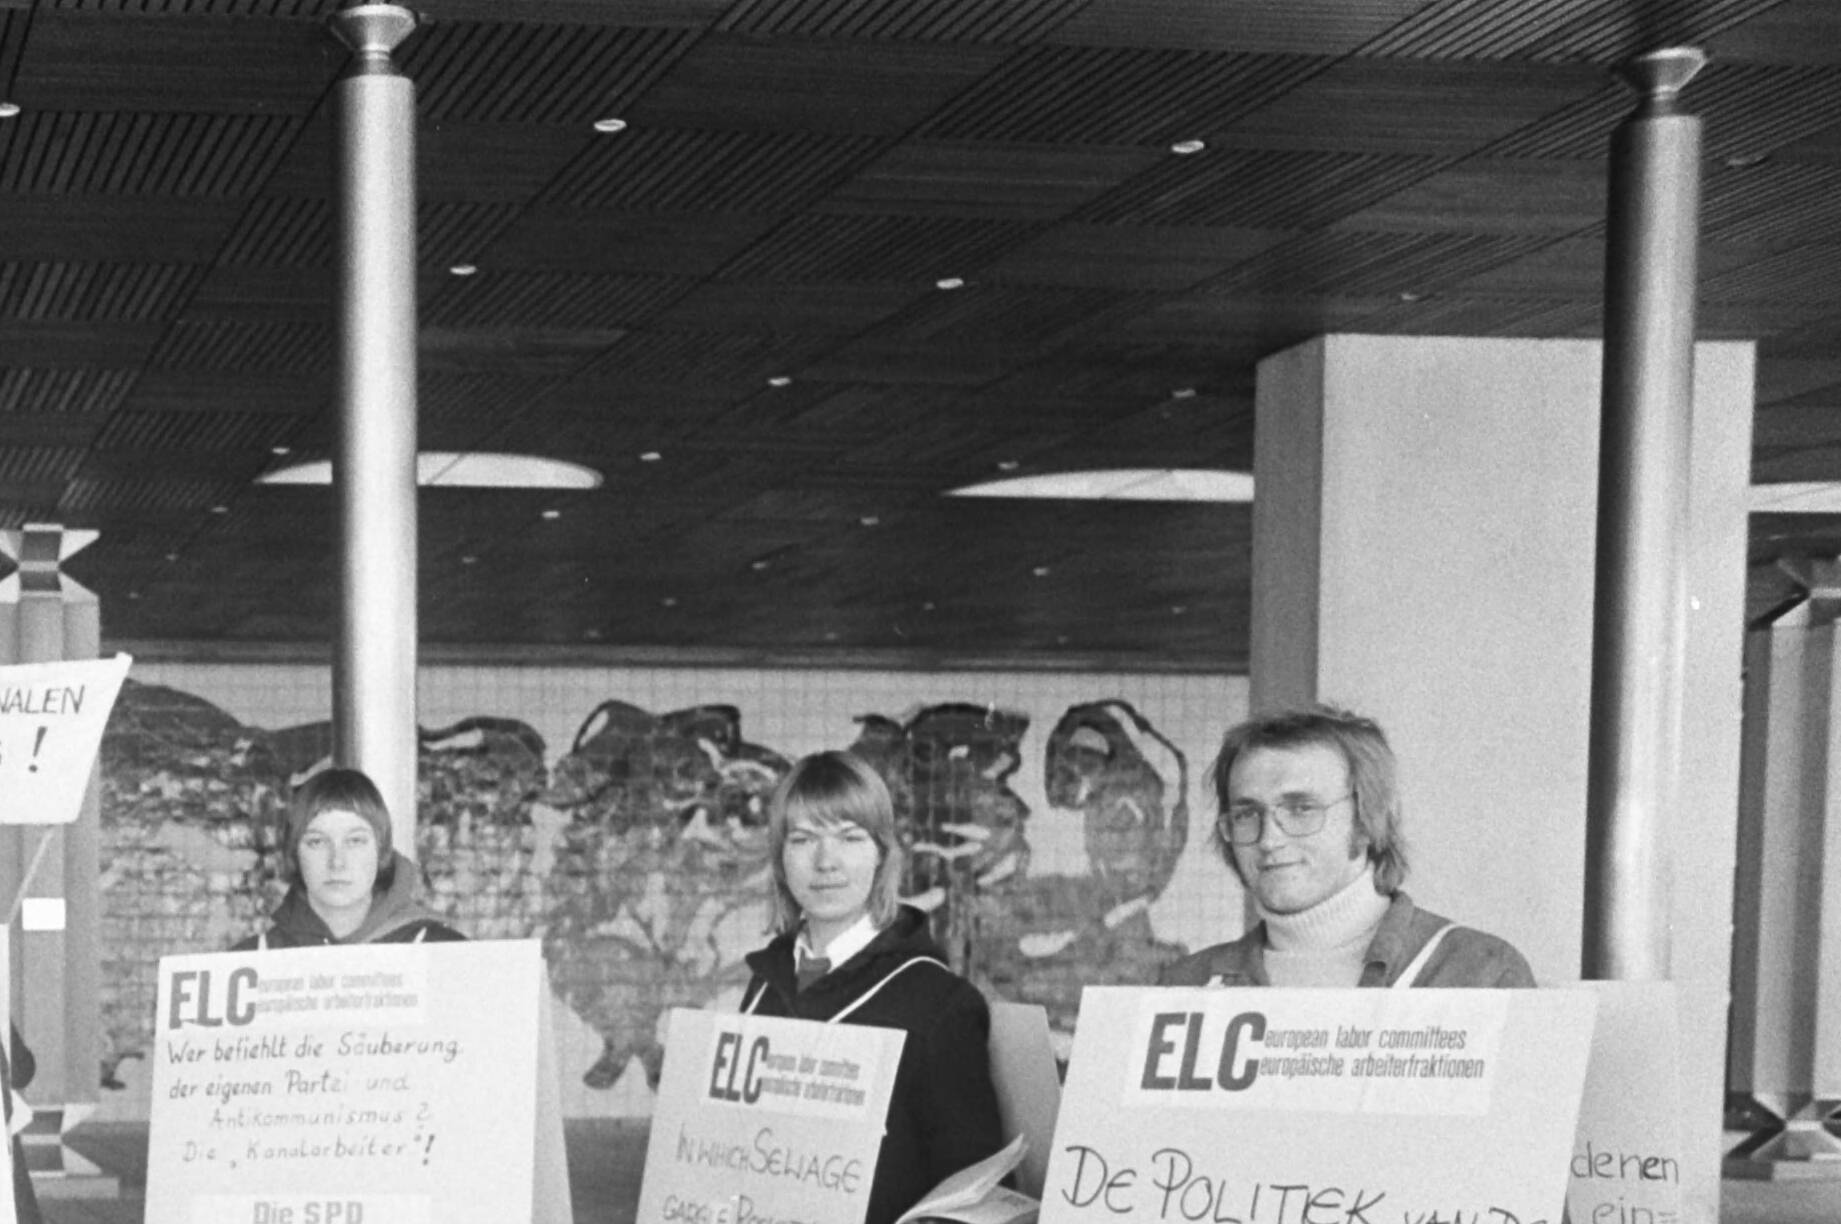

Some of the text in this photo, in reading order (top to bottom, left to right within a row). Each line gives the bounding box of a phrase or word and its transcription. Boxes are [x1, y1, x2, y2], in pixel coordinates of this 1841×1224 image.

[169, 967, 258, 1030] ELC
[168, 1039, 206, 1064] Wer
[214, 1033, 286, 1062] befiehlt
[295, 1034, 324, 1059] die
[1141, 1011, 1267, 1091] ELC
[1264, 1025, 1467, 1052] european labor committees
[709, 1031, 770, 1105] ELC
[1260, 1053, 1484, 1079] europäische arbeiterfraktionen
[169, 1078, 198, 1099] der
[205, 1074, 272, 1104] eigenen
[366, 1073, 411, 1091] und
[182, 1140, 216, 1162] Die
[1062, 1145, 1137, 1213] DE
